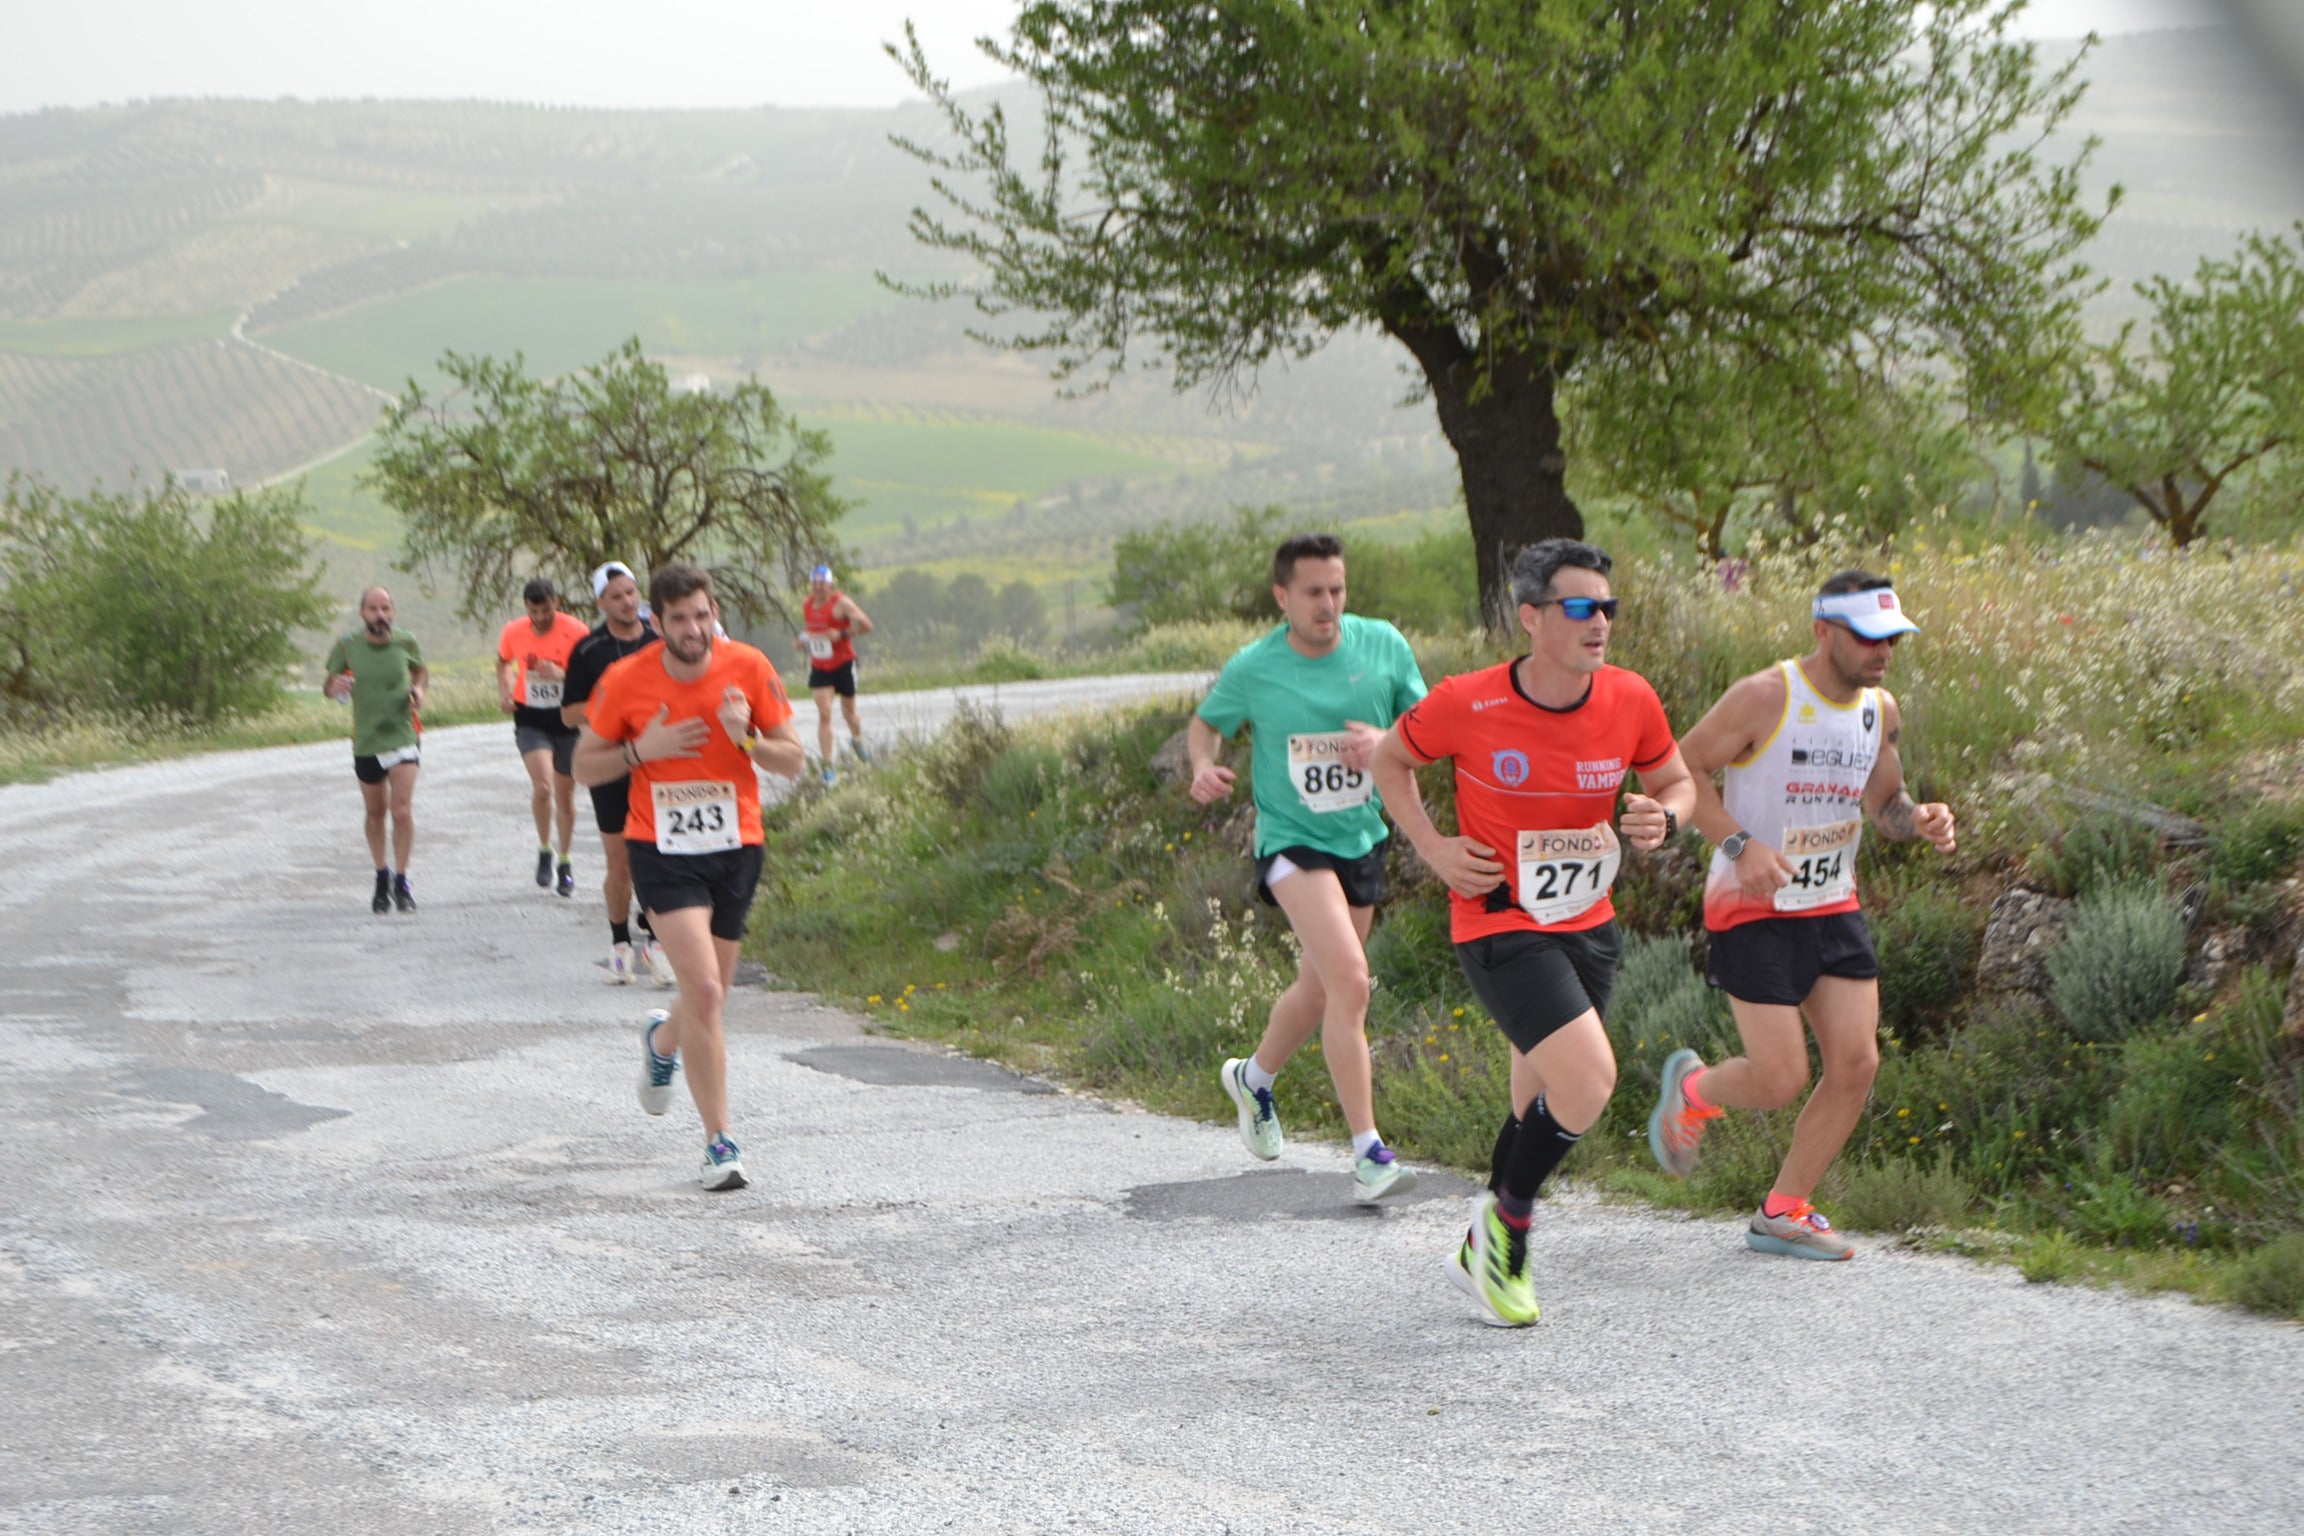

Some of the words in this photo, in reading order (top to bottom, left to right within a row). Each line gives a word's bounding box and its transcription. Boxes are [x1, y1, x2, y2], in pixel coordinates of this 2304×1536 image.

[531, 684, 559, 699] 563
[1305, 764, 1363, 794] 865
[1576, 757, 1621, 773] RUNNING
[668, 805, 724, 834] 243
[1535, 861, 1603, 901] 271
[1791, 850, 1843, 889] 454
